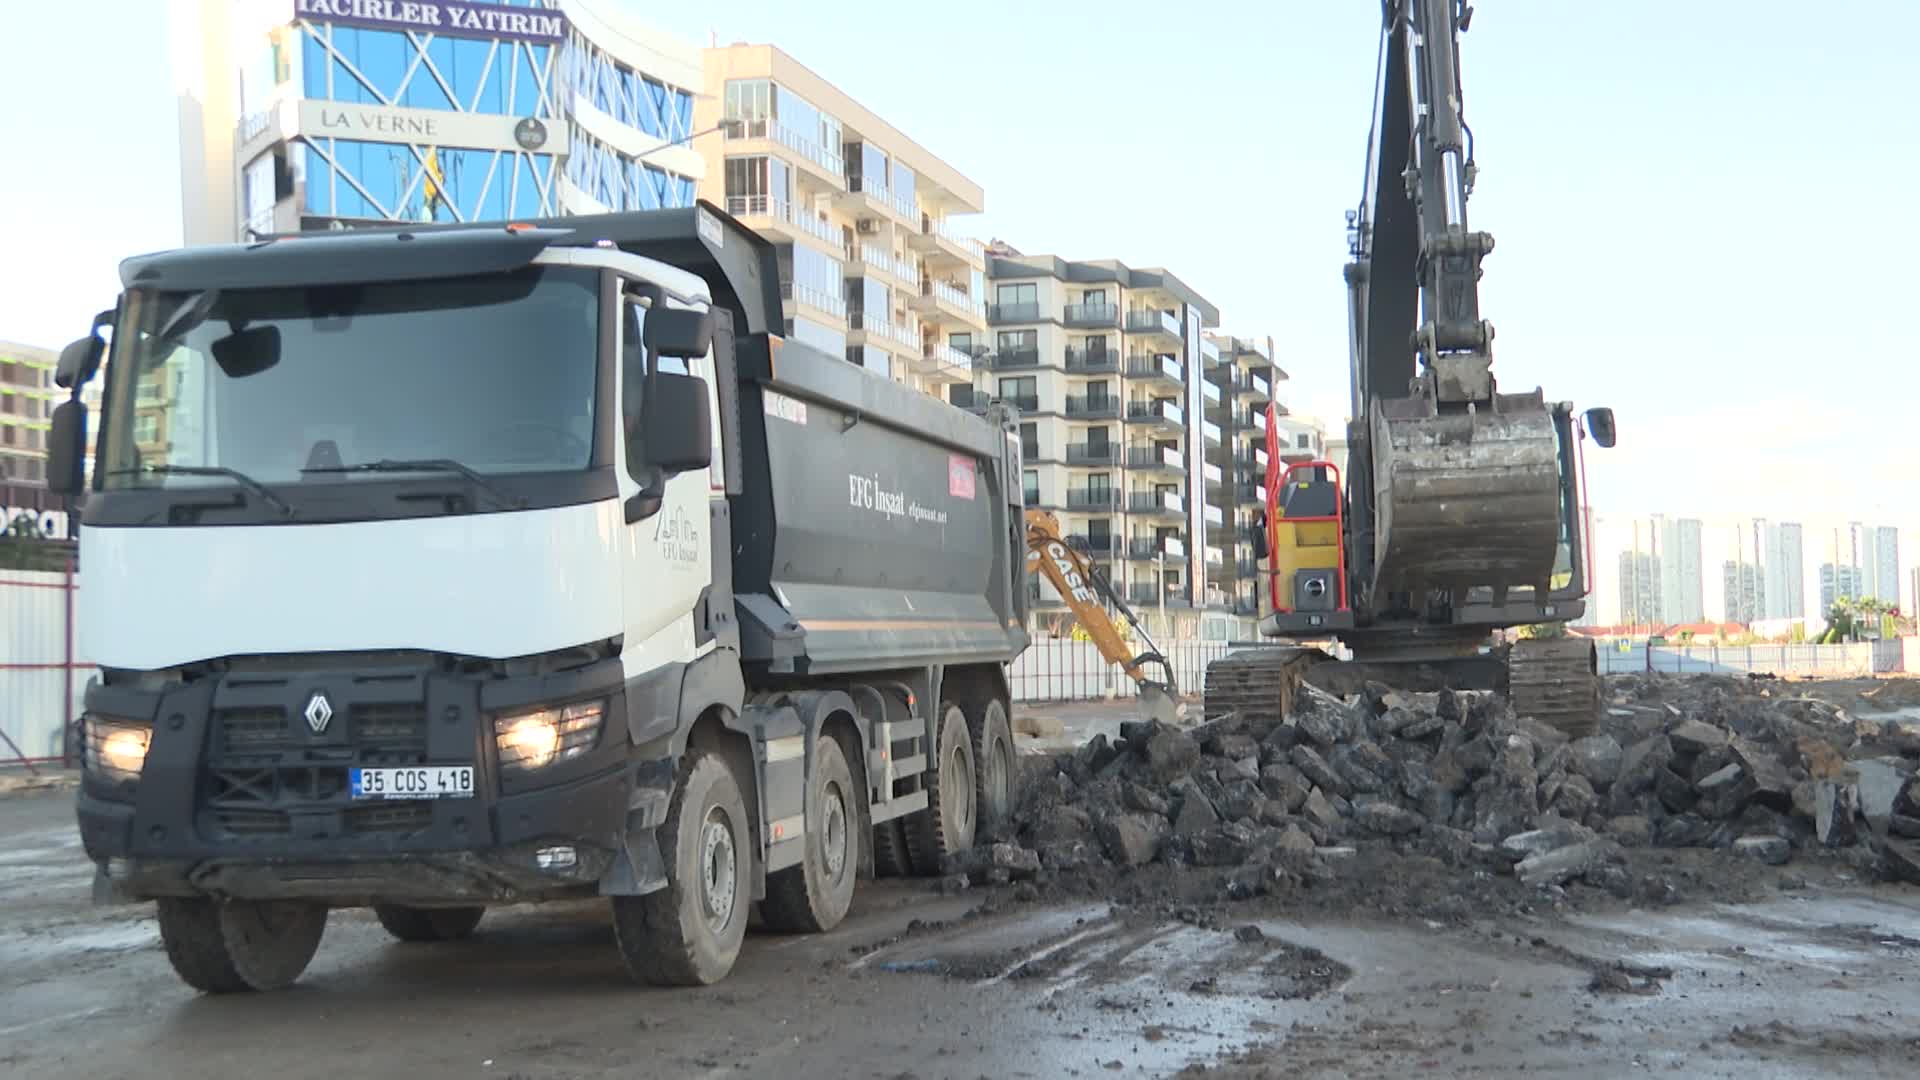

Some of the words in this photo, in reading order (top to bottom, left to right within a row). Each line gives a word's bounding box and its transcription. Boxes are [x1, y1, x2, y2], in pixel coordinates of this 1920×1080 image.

[446, 7, 563, 37] YATIRIM
[321, 109, 350, 128] LA
[359, 112, 438, 136] VERNE
[849, 473, 872, 510] EFG
[1047, 543, 1092, 602] CASE
[363, 771, 385, 792] 35
[395, 770, 428, 791] COS
[437, 769, 471, 791] 418
